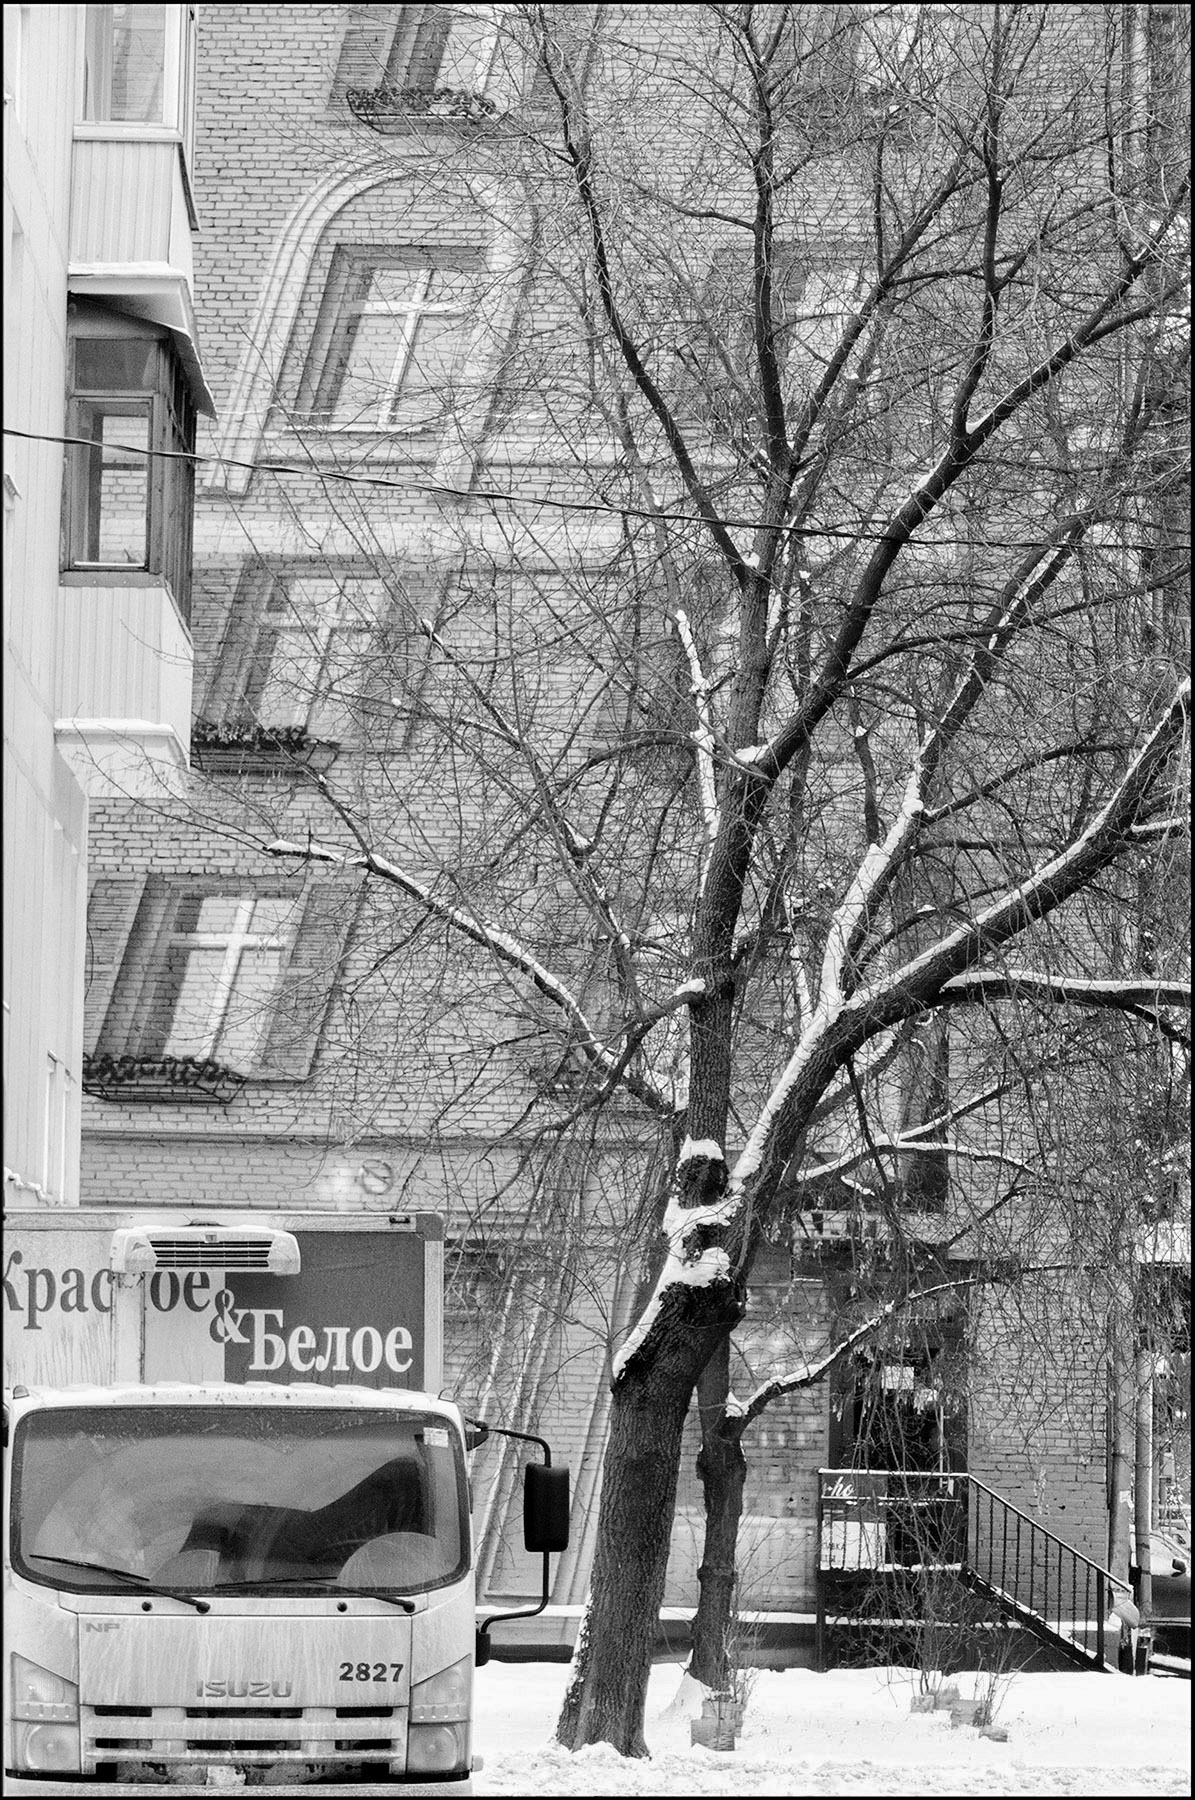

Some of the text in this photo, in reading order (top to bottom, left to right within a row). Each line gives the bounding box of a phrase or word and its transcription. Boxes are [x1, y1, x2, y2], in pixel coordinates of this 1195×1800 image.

[249, 1308, 413, 1372] Белое
[339, 1662, 404, 1682] 2827
[196, 1680, 292, 1698] ISUZU
